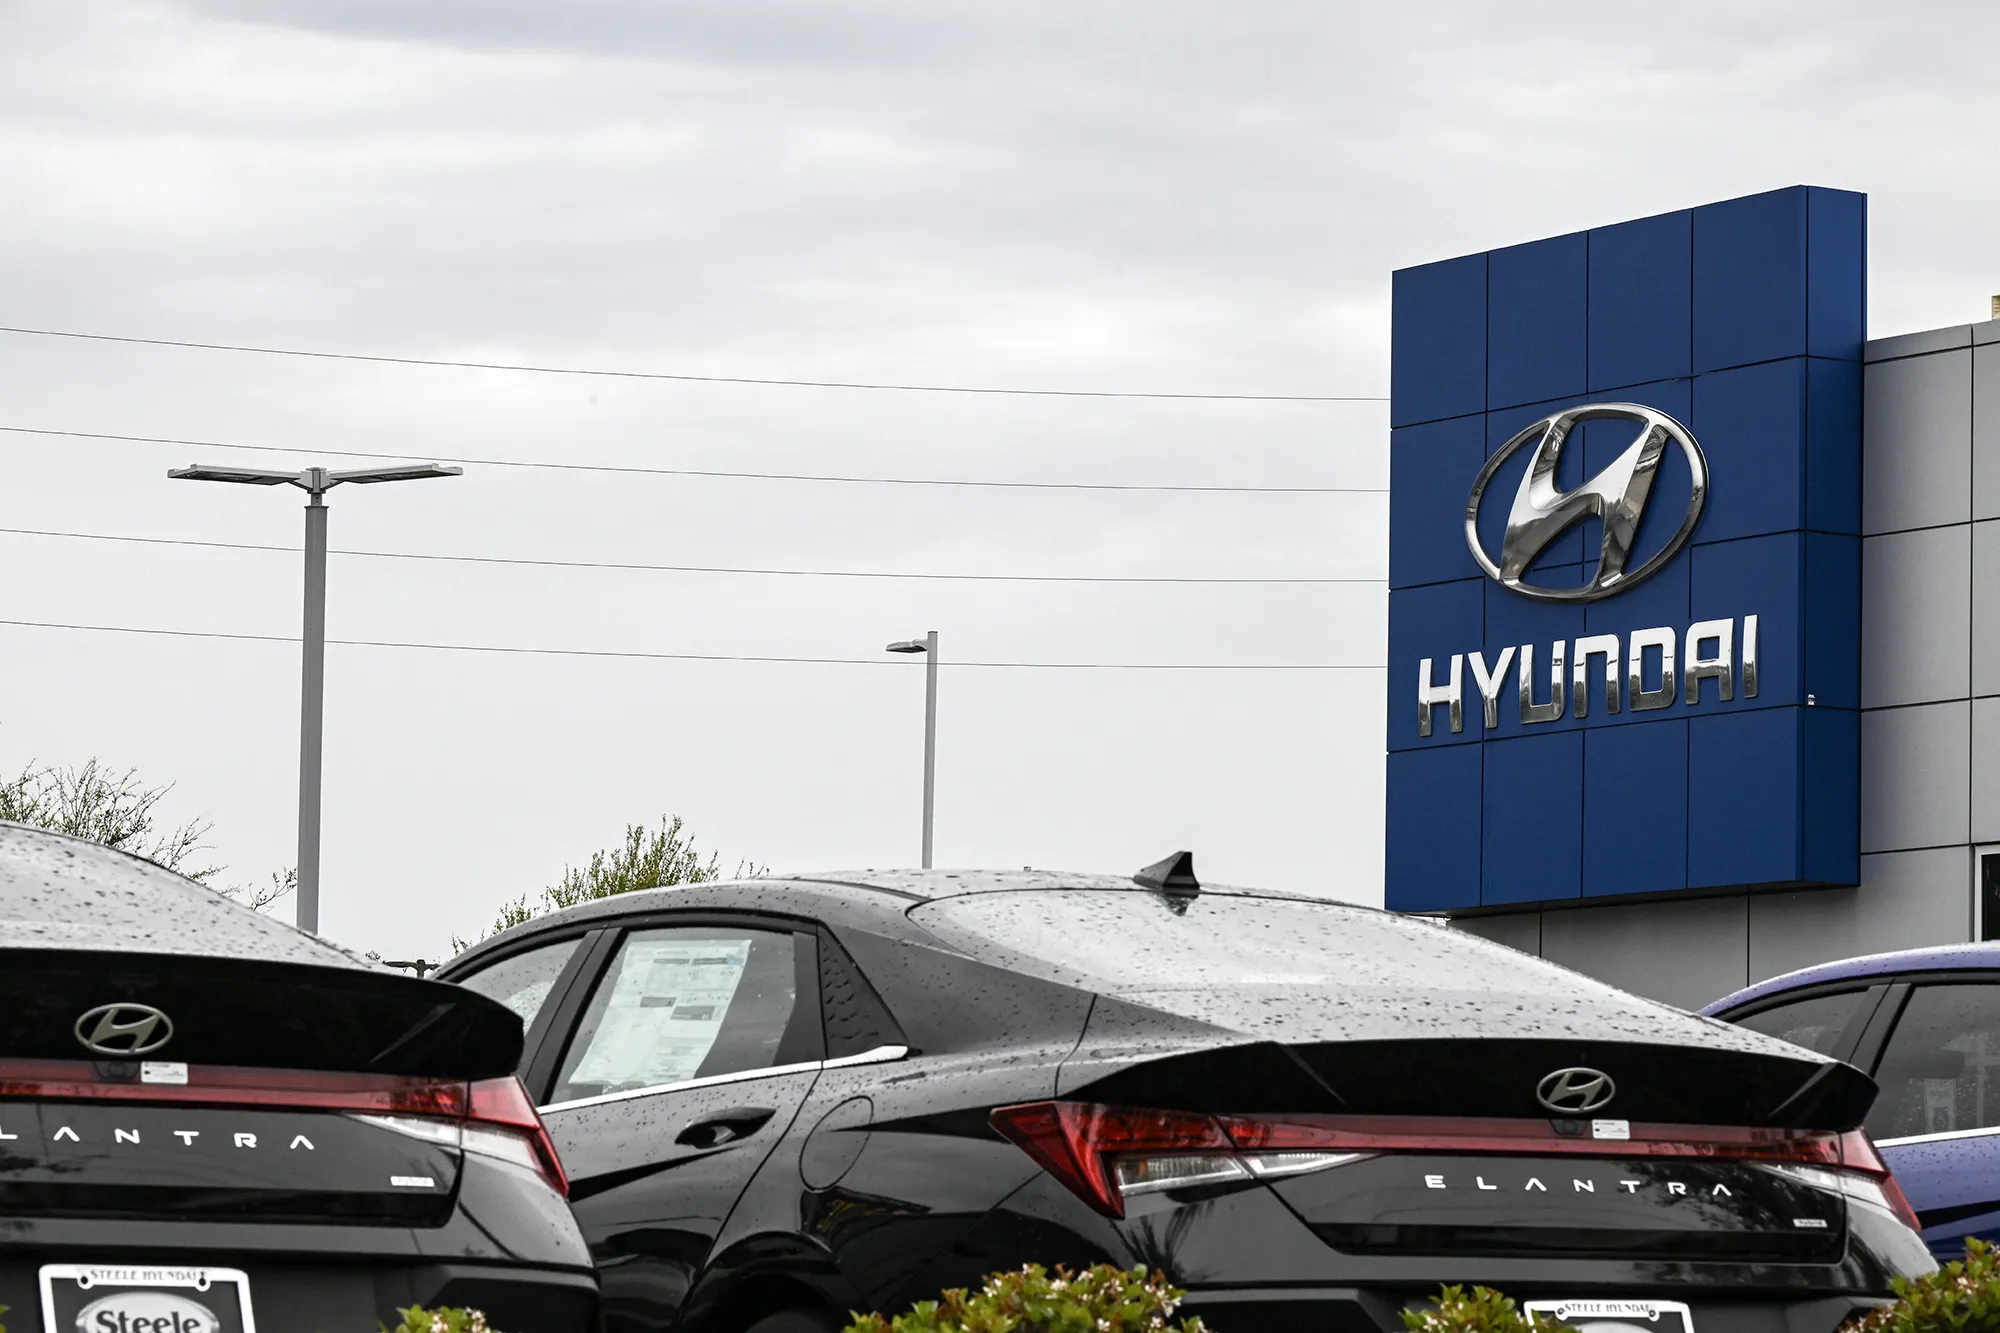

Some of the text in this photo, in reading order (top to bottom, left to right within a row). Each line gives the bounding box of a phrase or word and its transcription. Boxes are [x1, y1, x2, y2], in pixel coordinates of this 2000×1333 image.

[1418, 614, 1759, 737] HYUNDAI
[1424, 1174, 1733, 1197] ELANTRA
[90, 1269, 137, 1280] STEELE
[1564, 1303, 1601, 1312] STEELE
[95, 1309, 201, 1333] Steele
